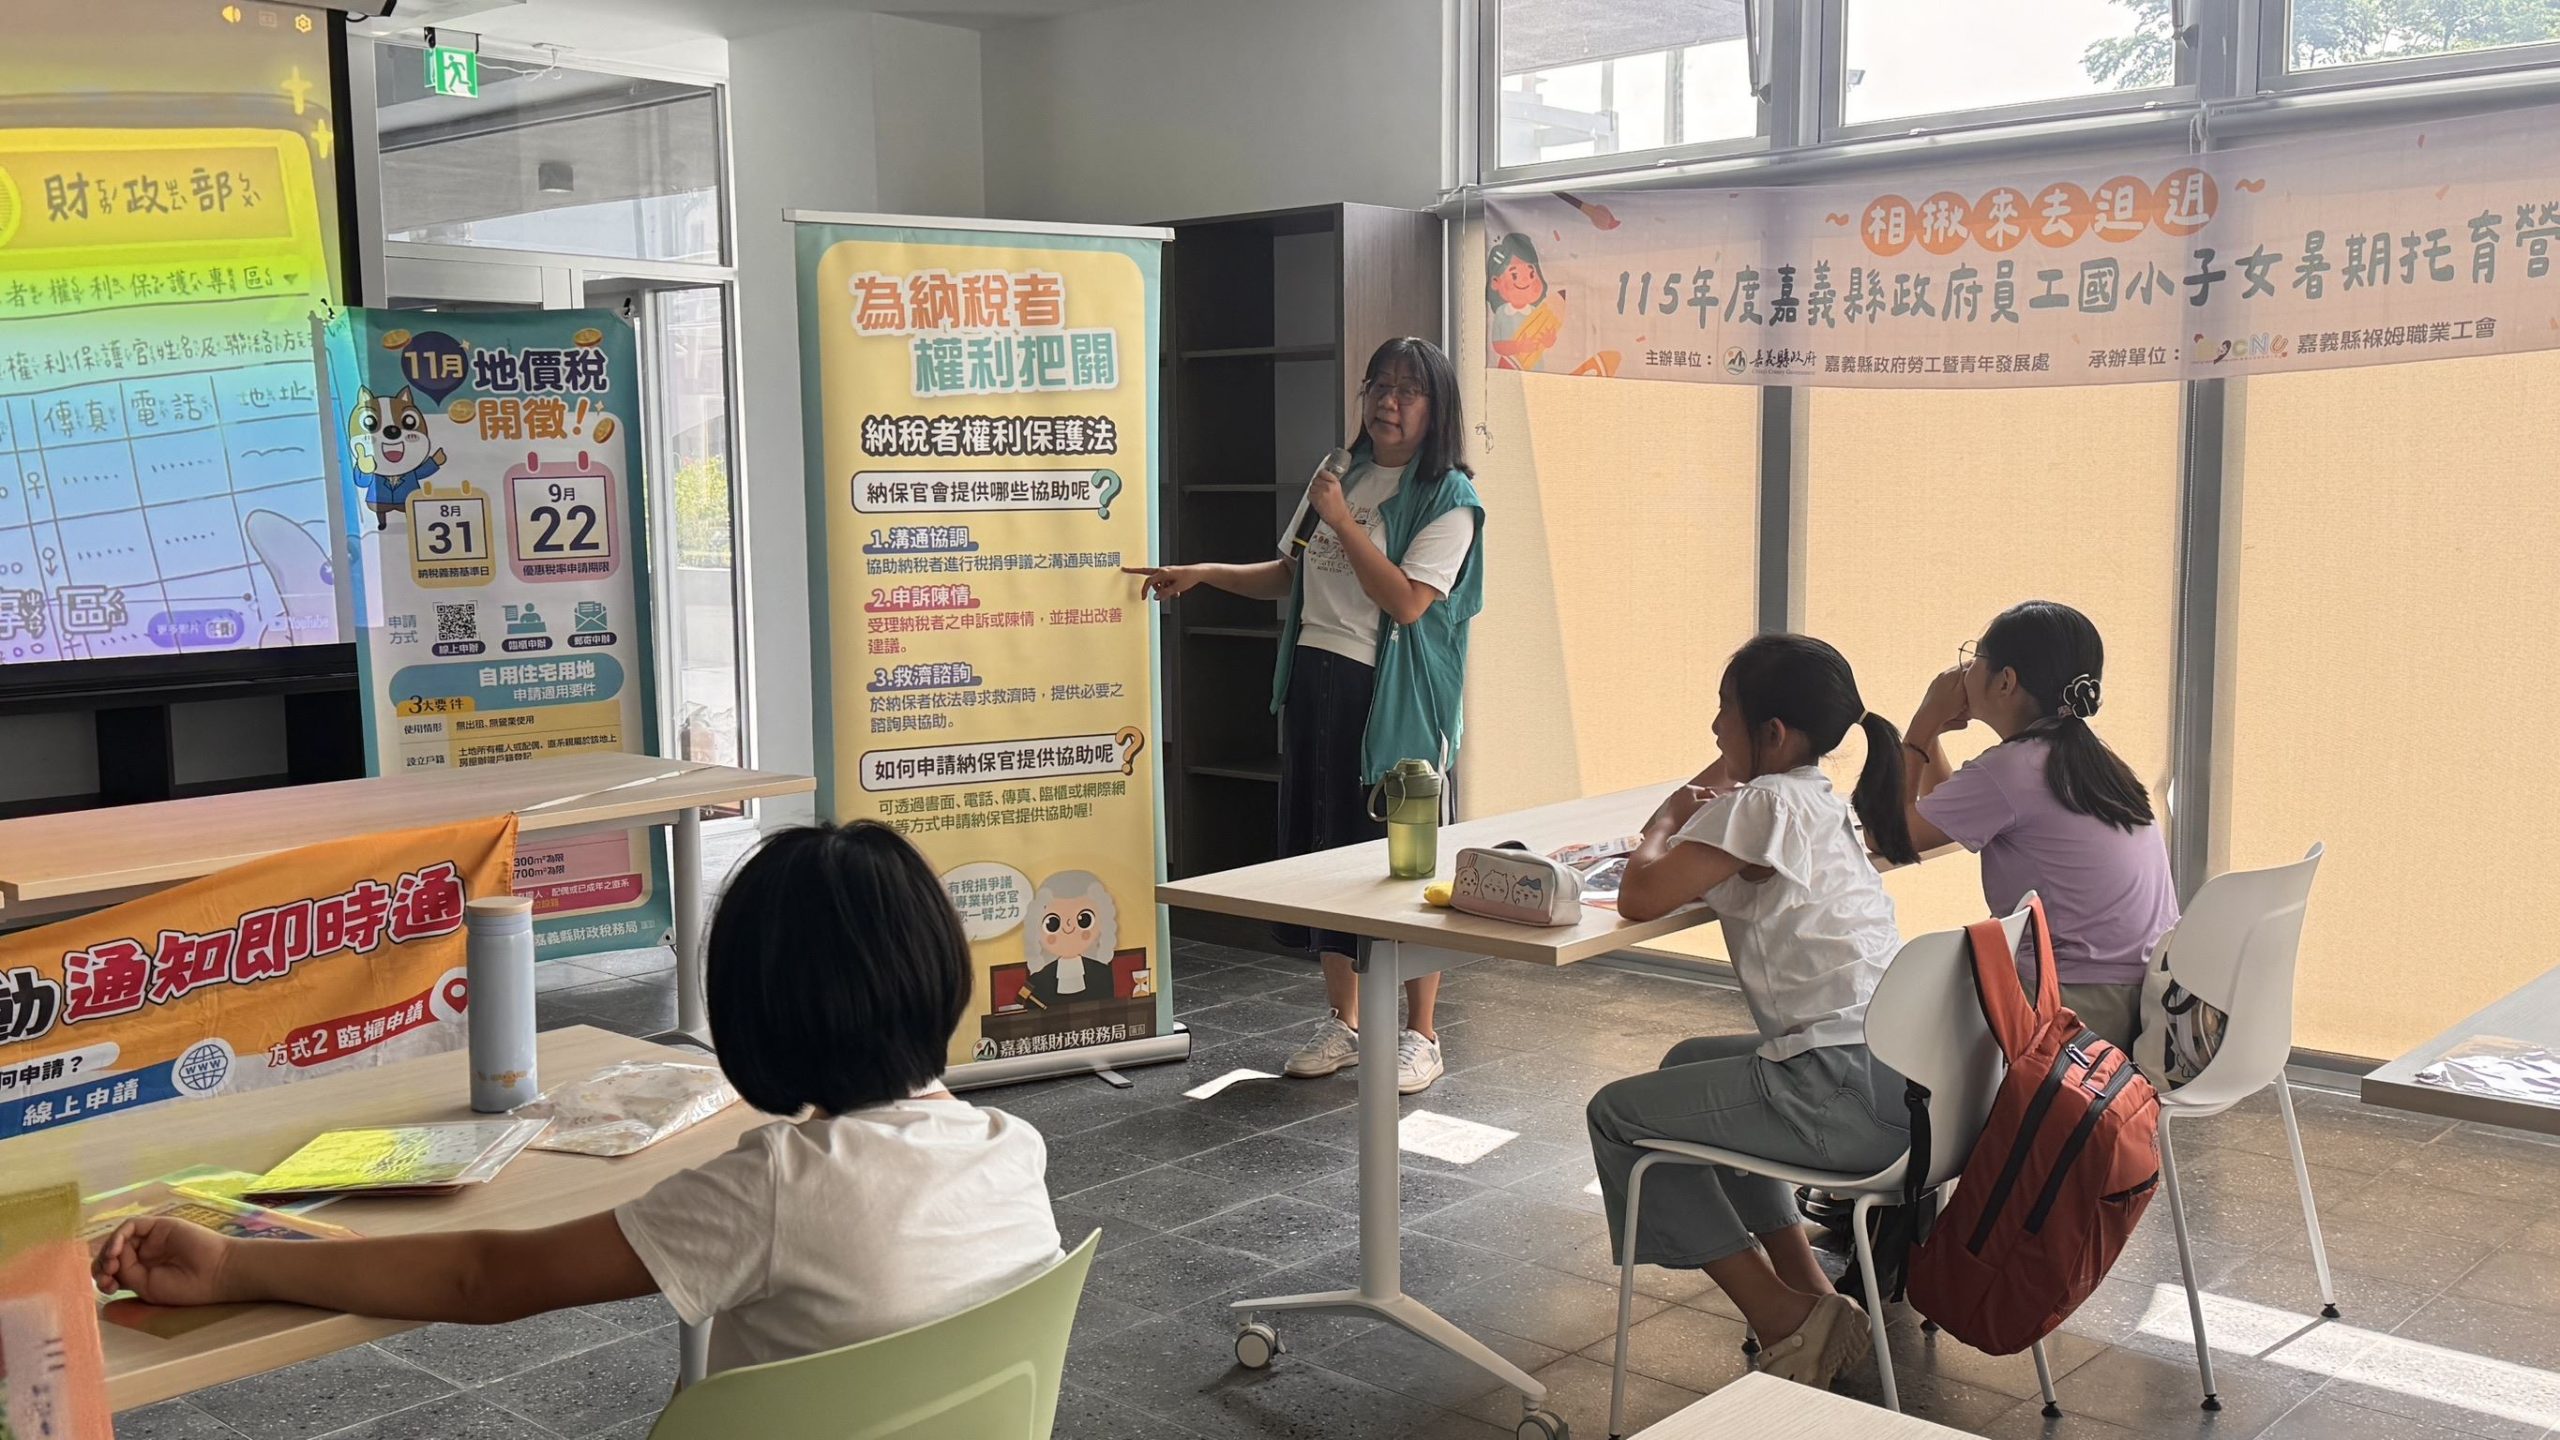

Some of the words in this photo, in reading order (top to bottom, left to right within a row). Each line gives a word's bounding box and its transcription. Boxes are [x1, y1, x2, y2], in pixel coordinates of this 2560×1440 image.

[855, 274, 1061, 330] 為納稅者
[8, 329, 312, 382] 權利保護官姓名及聯絡方
[1645, 349, 1712, 368] 主辦單位:
[1824, 352, 2050, 376] 嘉義縣政府勞工暨青年發展處
[2296, 316, 2497, 354] 嘉義縣褓姆職業工會
[405, 351, 463, 380] 11月
[474, 349, 607, 392] 地價稅
[914, 333, 1115, 392] 權利把關
[864, 418, 1115, 453] 納稅者權利保護法
[548, 484, 576, 503] 9月
[440, 504, 461, 517] 8月
[427, 521, 473, 554] 31
[529, 504, 600, 552] 22
[872, 528, 968, 550] 1.溝通協調
[866, 552, 1121, 575] 協助納稅者進行稅捐爭議之溝通與協調
[873, 586, 970, 608] 2.申訴陳情
[388, 614, 417, 629] 申請
[389, 631, 418, 645] 方式
[479, 660, 596, 688] 自用住宅用地
[875, 664, 971, 687] 3.救濟諮詢
[408, 695, 464, 714] 3大要件
[513, 683, 596, 703] 申請適用要件
[404, 722, 442, 735] 使用情形
[948, 876, 1013, 894] 有稅捐爭議
[534, 920, 638, 946] 嘉義縣財政稅務局
[1000, 1024, 1126, 1057] 嘉義縣財政稅務局
[22, 1078, 139, 1127] 線上申請
